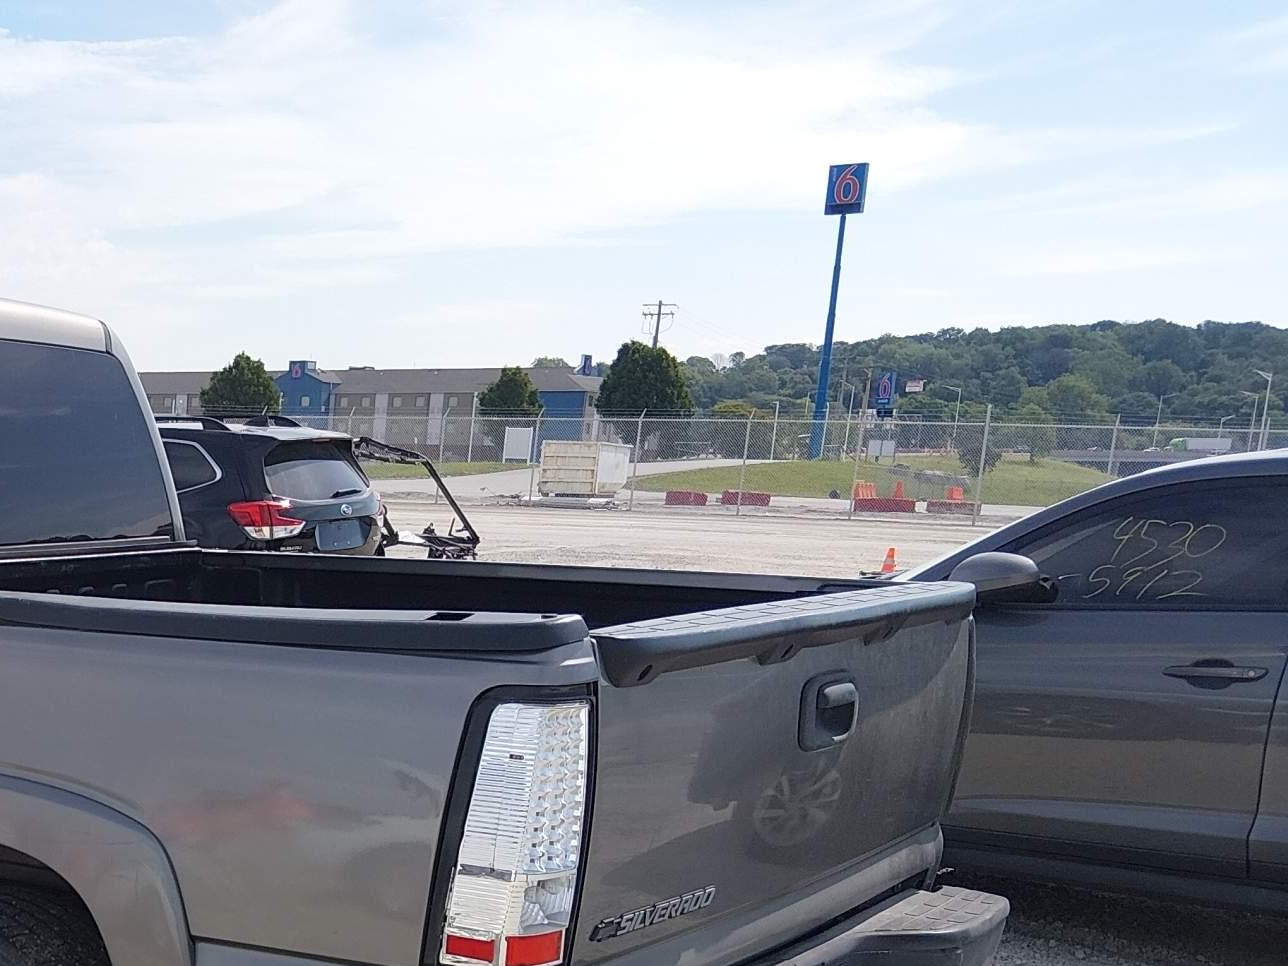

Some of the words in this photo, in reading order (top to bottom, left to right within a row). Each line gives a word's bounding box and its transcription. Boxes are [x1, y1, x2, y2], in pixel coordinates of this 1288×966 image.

[834, 164, 860, 205] 6
[879, 372, 891, 399] 6
[616, 885, 717, 936] SILVERADO
